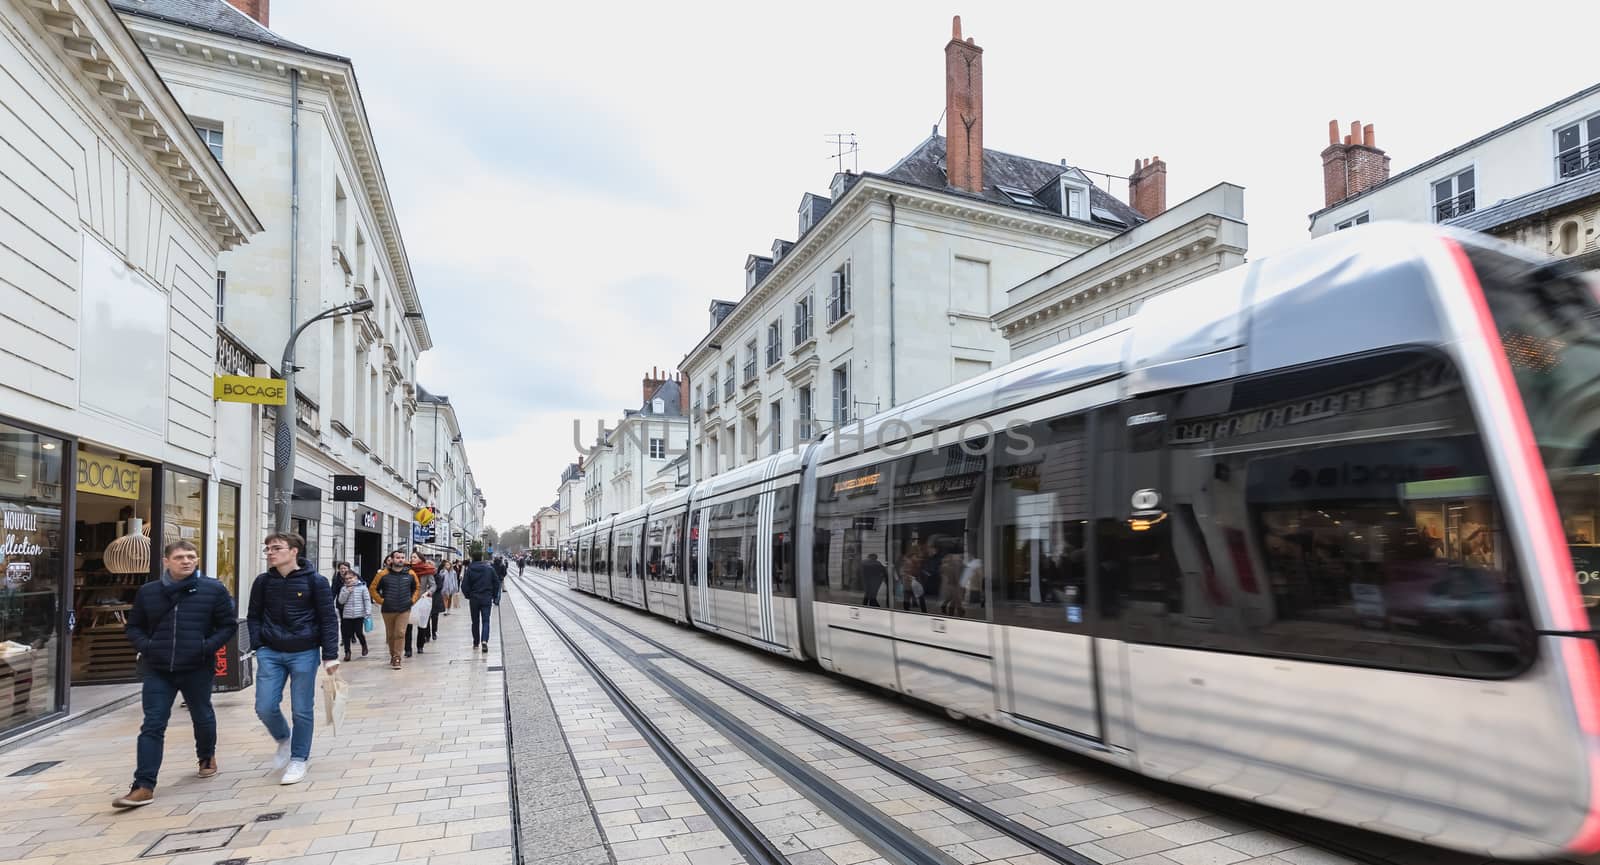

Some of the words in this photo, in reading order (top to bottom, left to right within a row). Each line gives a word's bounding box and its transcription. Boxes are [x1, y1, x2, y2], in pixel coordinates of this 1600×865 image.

[224, 384, 284, 399] BOCAGE
[79, 458, 137, 493] BOCAGE
[4, 511, 37, 531] NOUVELLE
